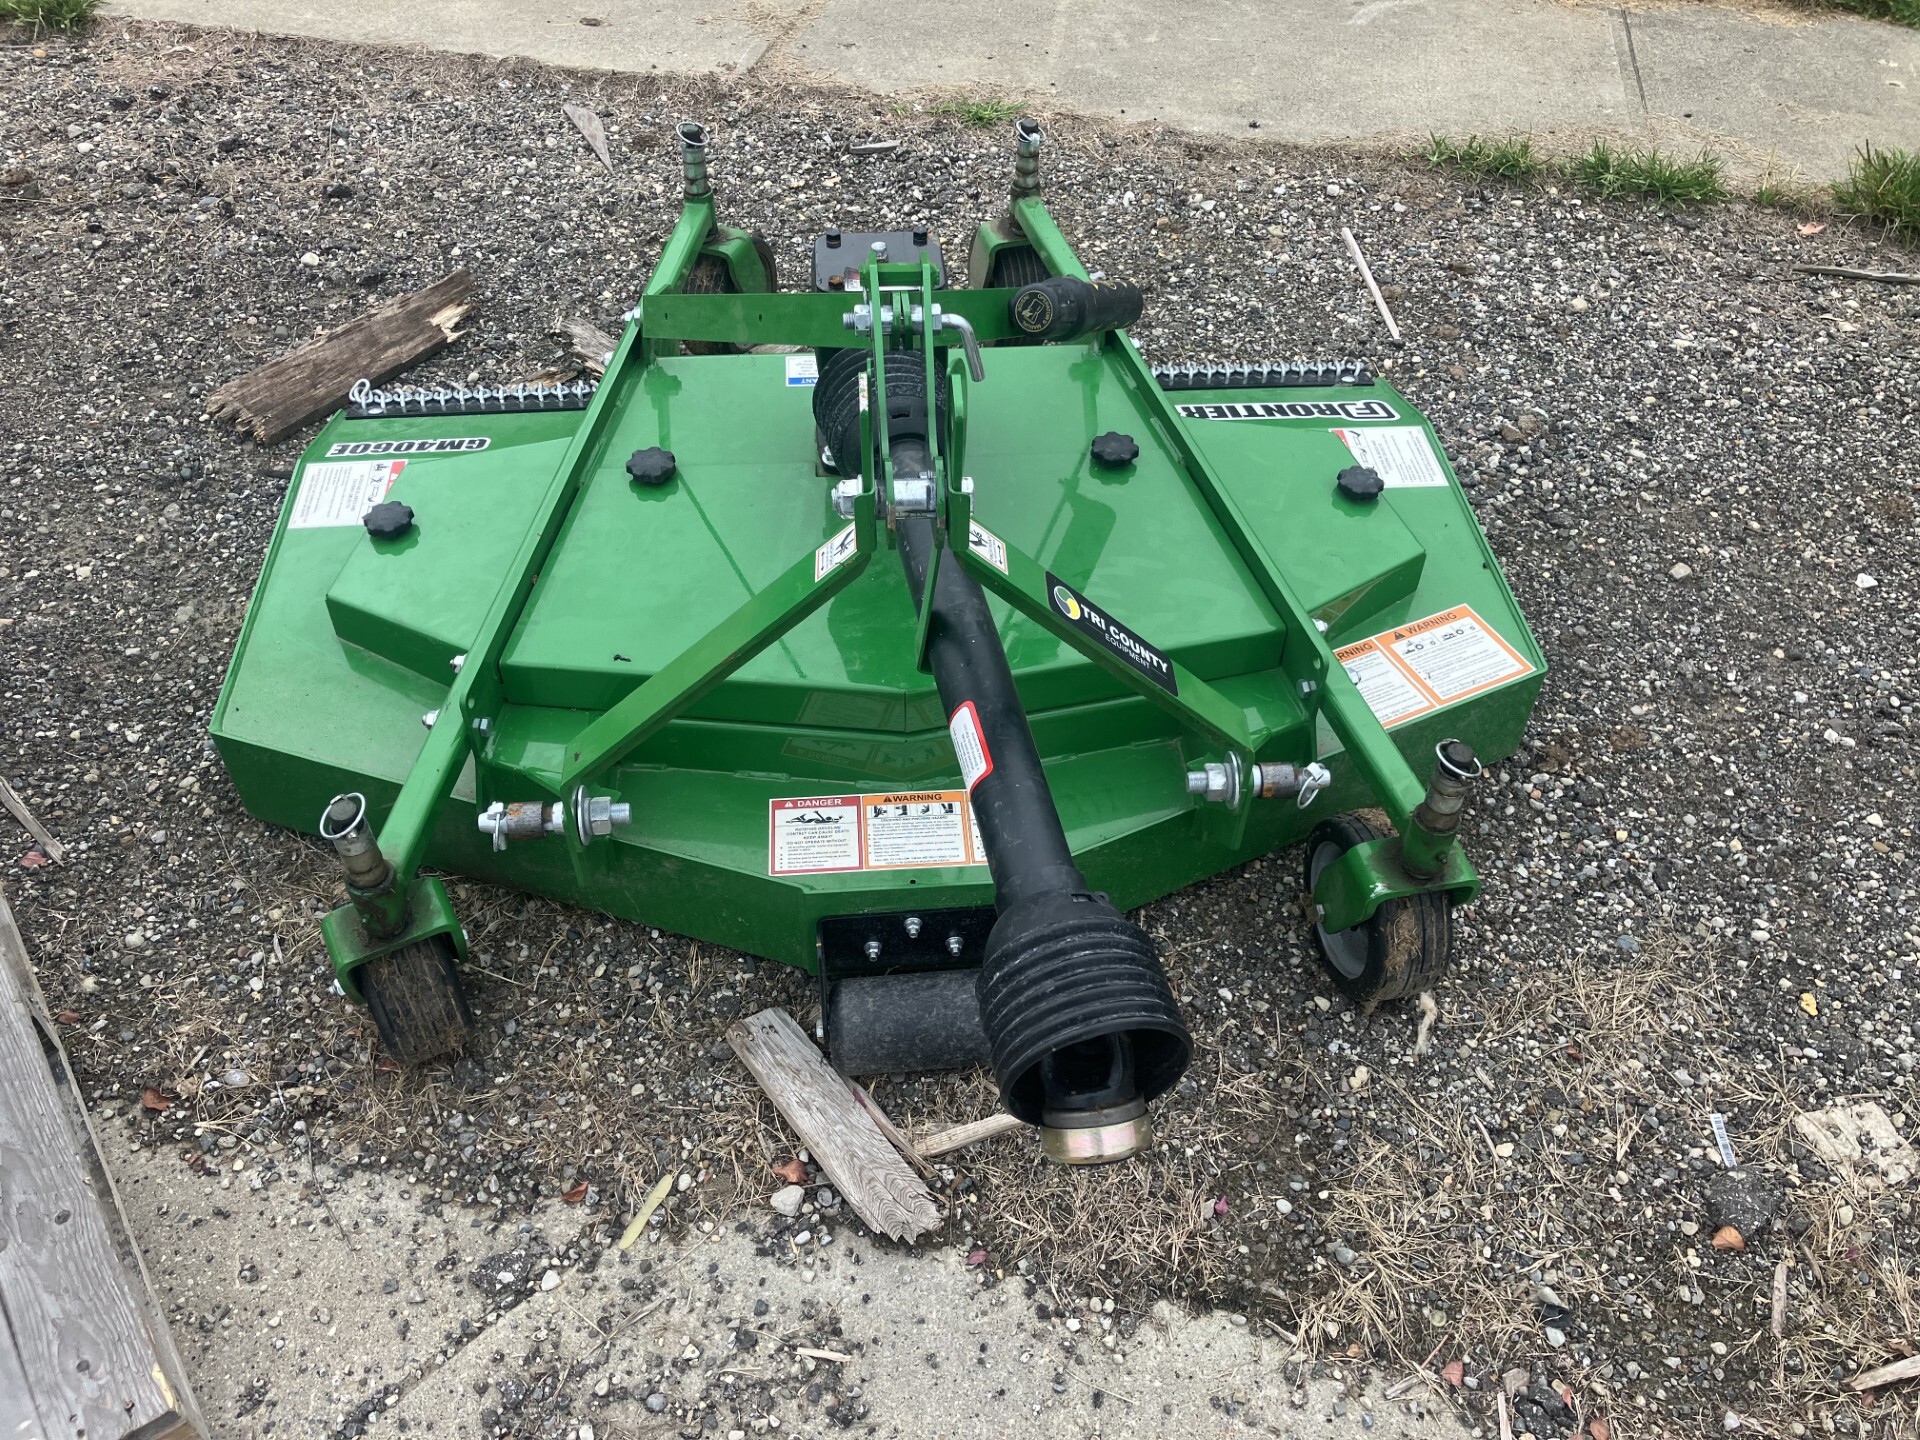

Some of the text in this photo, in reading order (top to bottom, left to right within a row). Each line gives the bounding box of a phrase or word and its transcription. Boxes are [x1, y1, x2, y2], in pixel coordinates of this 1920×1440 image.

[1181, 401, 1396, 420] FRONTIER
[330, 438, 488, 456] GM4060E
[1406, 612, 1457, 634] WARNING
[1081, 603, 1168, 673] TRI COUNTY
[1104, 633, 1151, 669] EQUIPMENT
[1336, 643, 1373, 660] RNING
[797, 798, 842, 808] DANGER
[892, 793, 943, 802] WARNING
